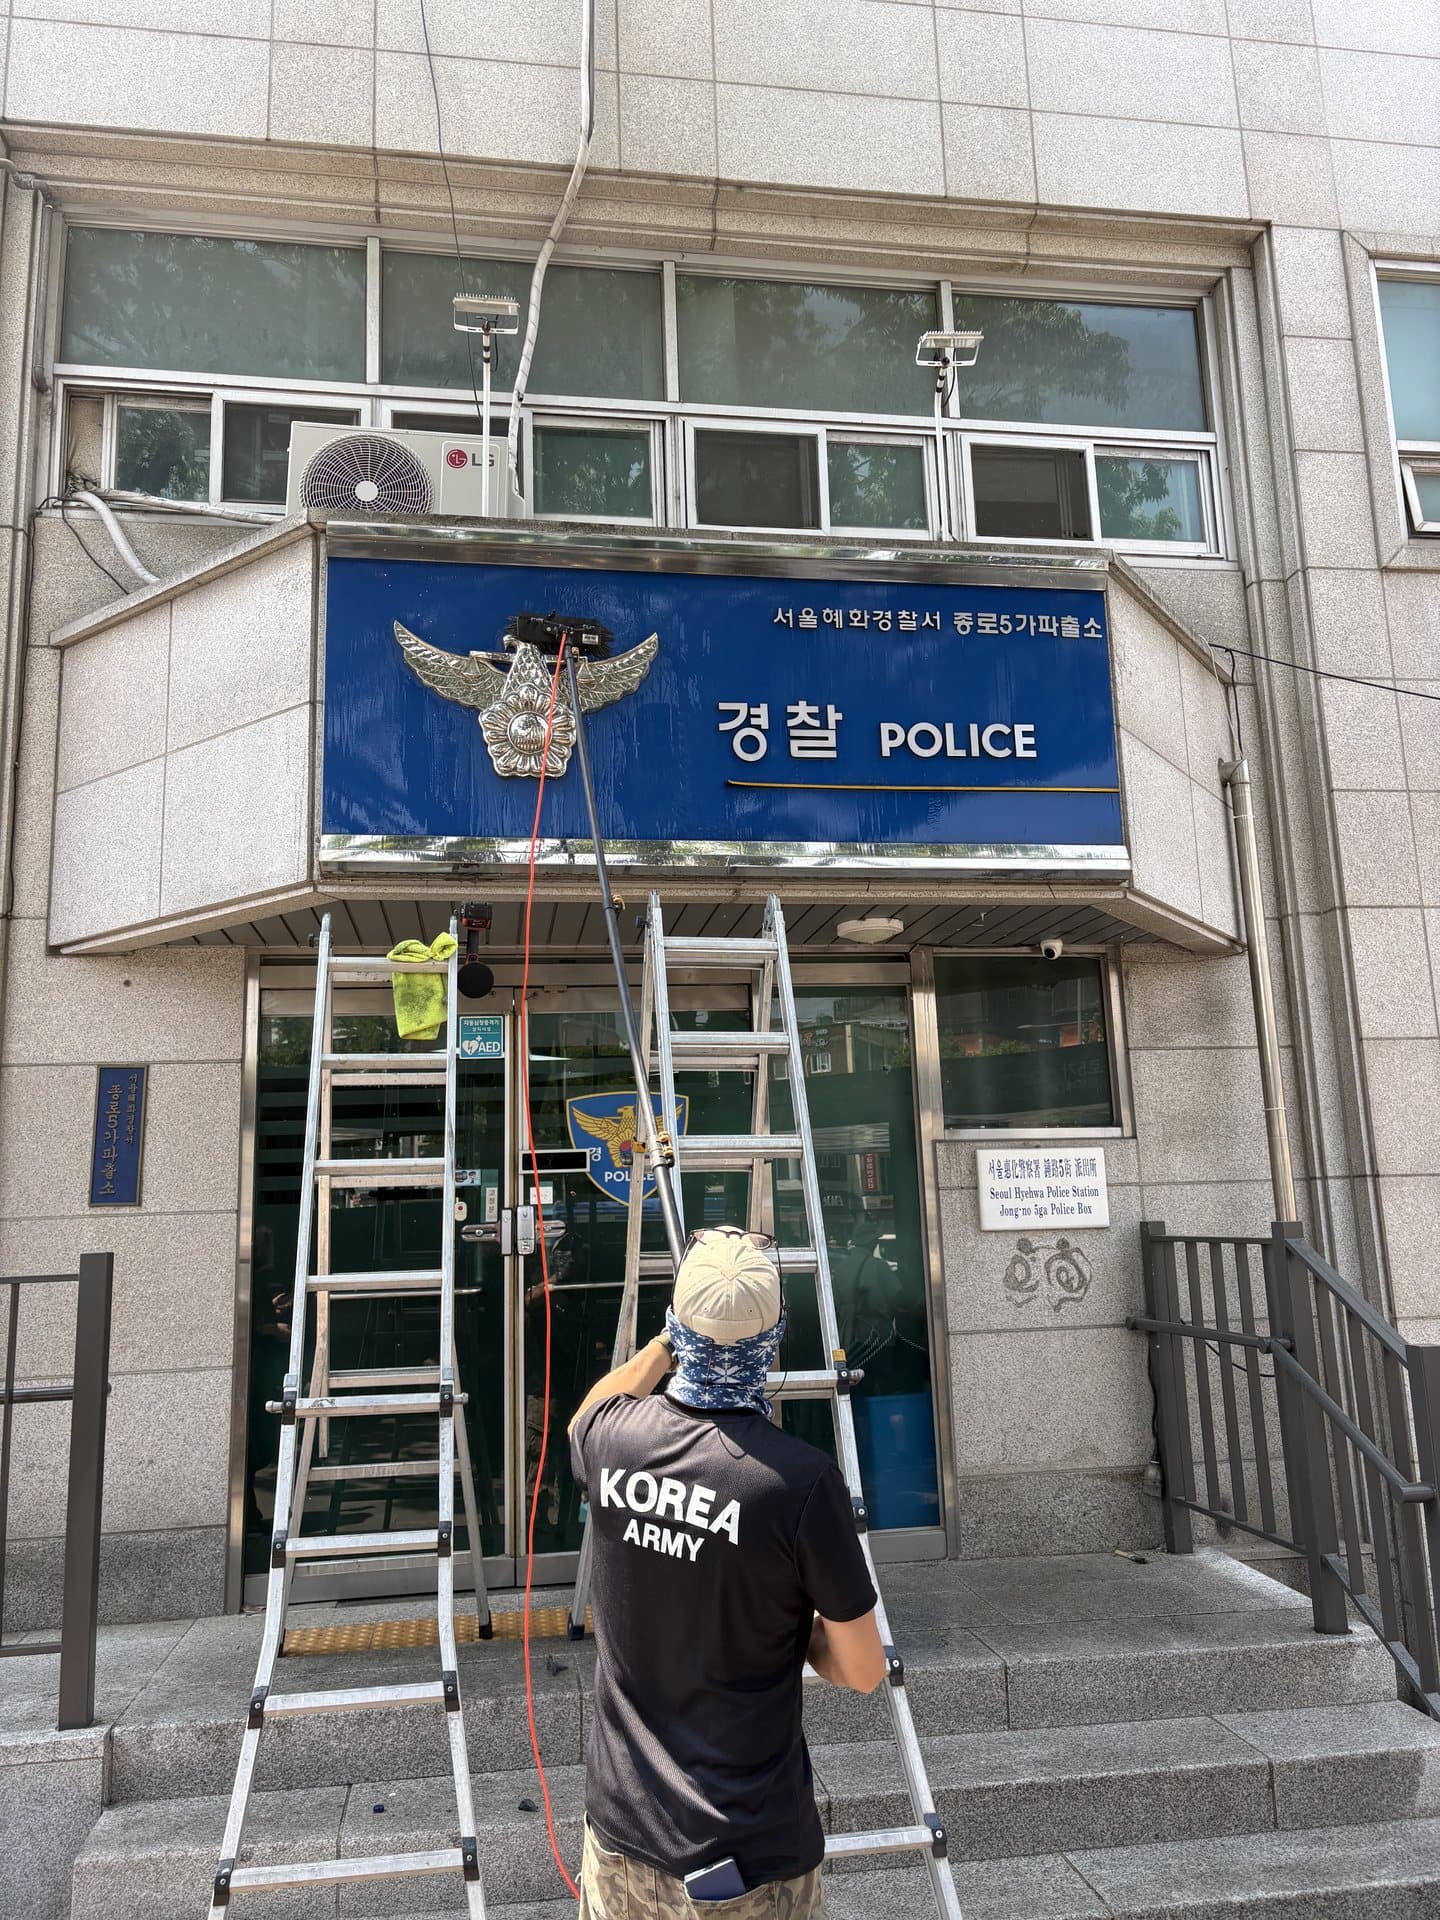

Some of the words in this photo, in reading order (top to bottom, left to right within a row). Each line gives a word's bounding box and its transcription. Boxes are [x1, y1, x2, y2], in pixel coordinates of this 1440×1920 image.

[773, 607, 941, 631] 서울혜화경찰서
[953, 611, 1103, 639] 종로5가파출소
[718, 700, 843, 762] 경찰
[880, 722, 1037, 759] POLICE
[478, 1041, 500, 1053] AED
[99, 1084, 124, 1195] 종로5가파출소
[990, 1187, 1012, 1200] Seoul
[1014, 1186, 1045, 1201] Hyehwa
[1047, 1185, 1070, 1198] Police
[1072, 1184, 1099, 1197] Station
[1034, 1204, 1048, 1218] 5ga
[1050, 1202, 1075, 1216] Police
[1077, 1201, 1093, 1215] Box
[600, 1467, 741, 1546] KOREA
[622, 1518, 705, 1562] ARMY
